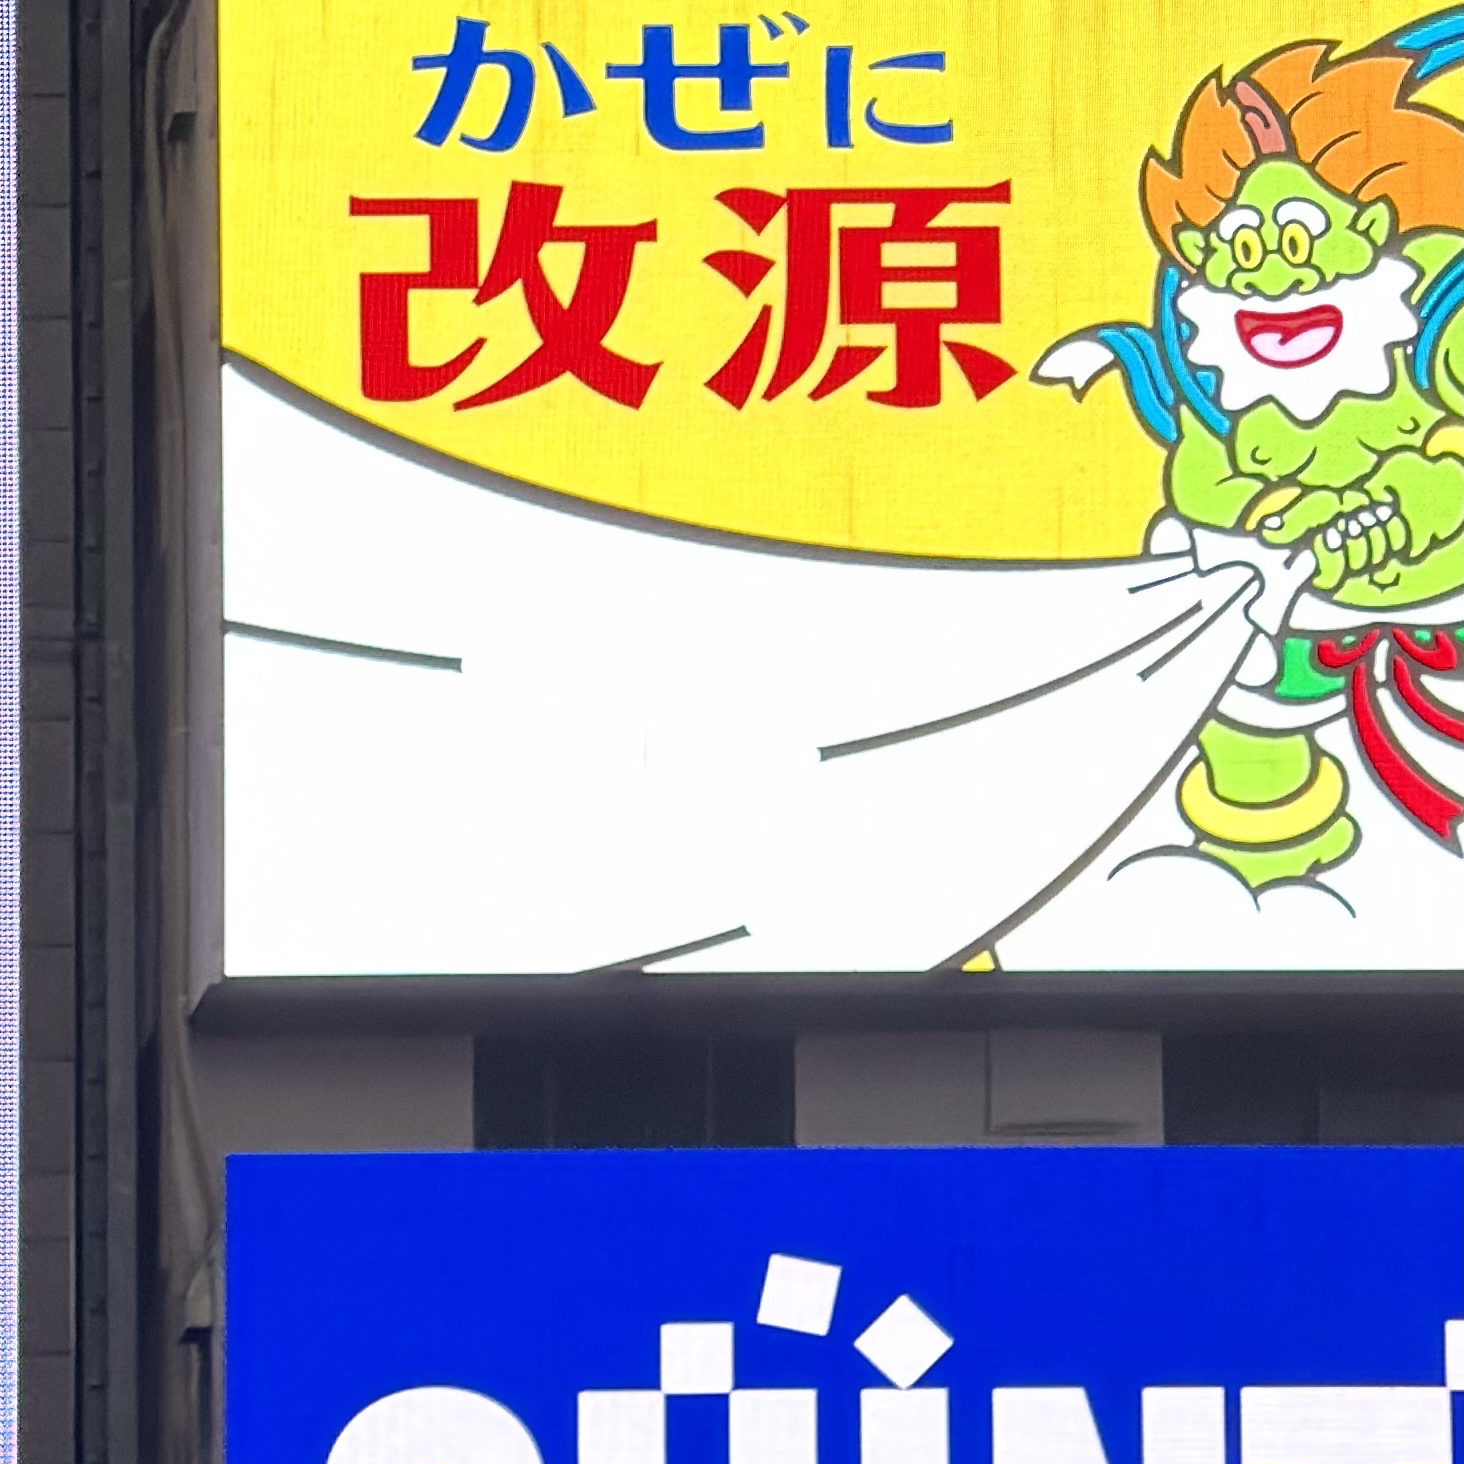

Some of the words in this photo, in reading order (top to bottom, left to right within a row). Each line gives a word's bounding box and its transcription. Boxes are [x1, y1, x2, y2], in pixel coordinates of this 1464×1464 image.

[411, 10, 954, 152] かぜに
[349, 179, 1018, 411] 改源
